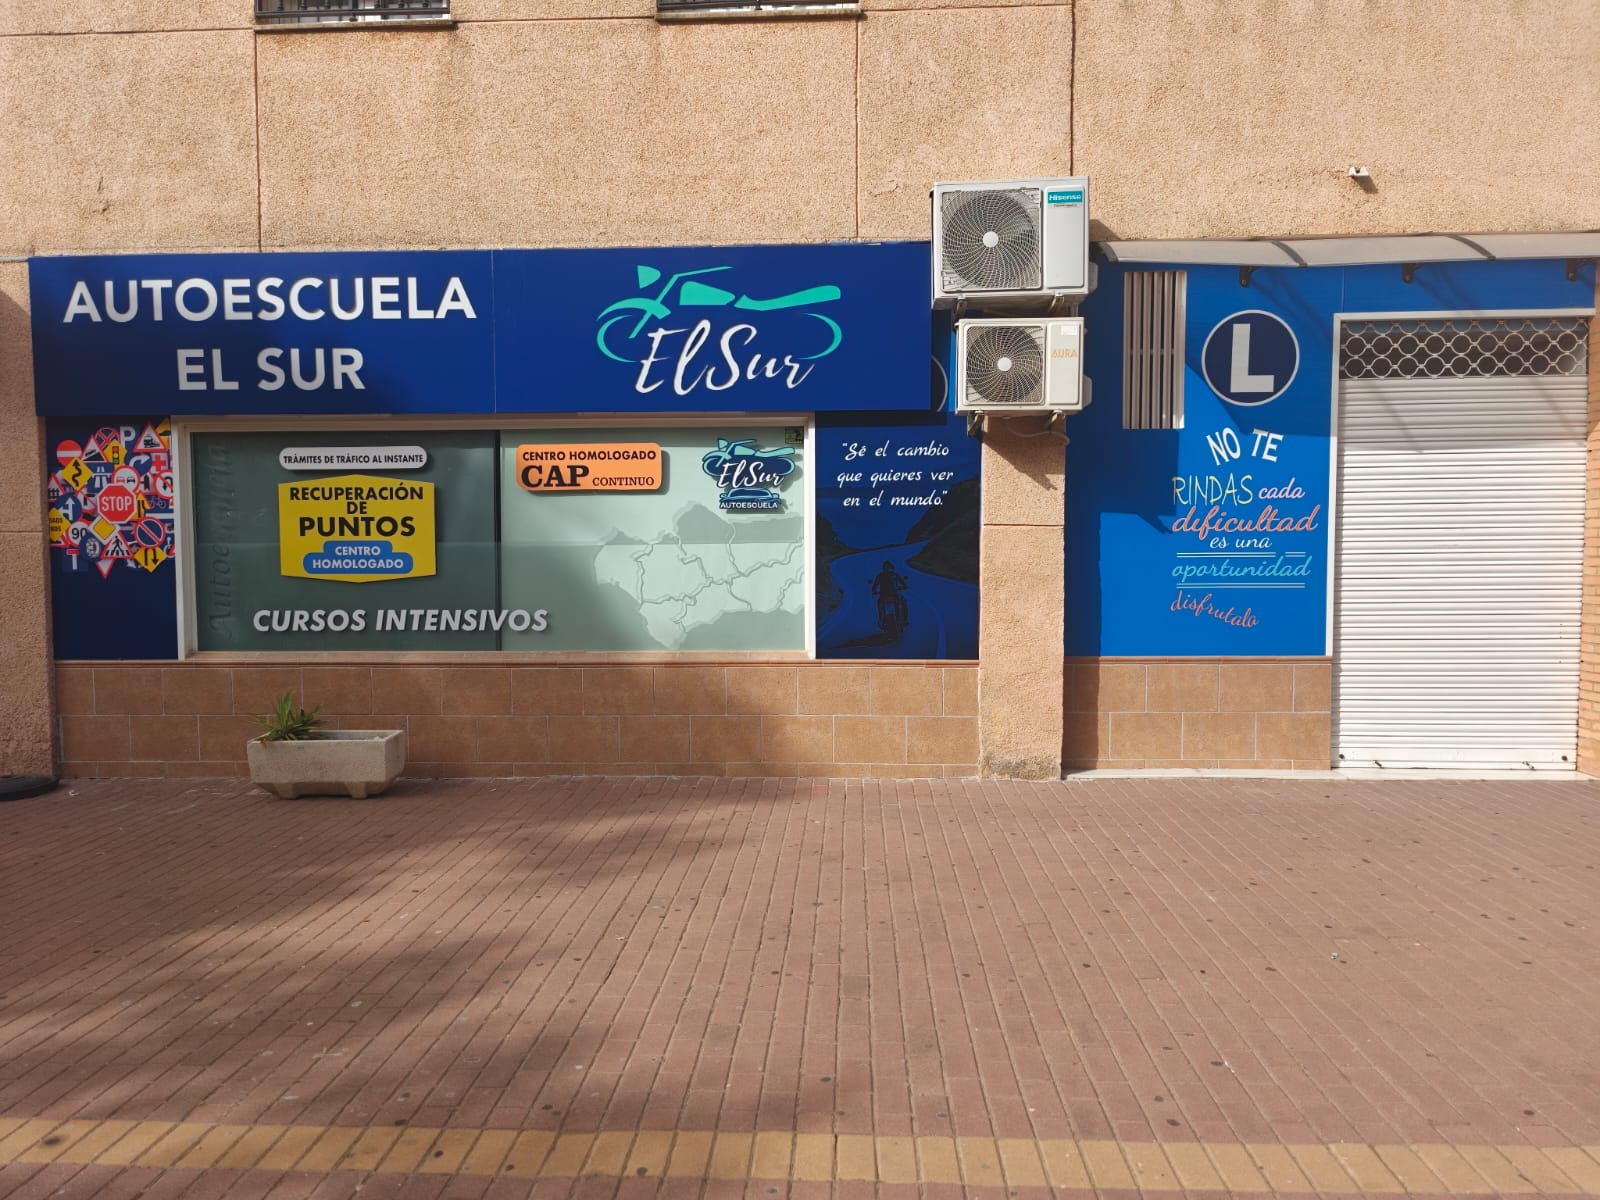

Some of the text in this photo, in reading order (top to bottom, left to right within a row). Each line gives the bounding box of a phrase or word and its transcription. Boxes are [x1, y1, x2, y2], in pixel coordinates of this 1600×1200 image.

[1049, 193, 1082, 201] Hisense
[62, 276, 478, 323] AUTOESCUELA
[1230, 323, 1275, 393] L
[176, 347, 366, 391] EL SUR
[522, 450, 657, 461] CENTRO HOMOLOGADO
[874, 440, 890, 457] el
[897, 440, 949, 457] cambio
[1205, 427, 1284, 466] NO TE
[324, 454, 335, 463] DE
[372, 454, 382, 463] AL
[384, 454, 424, 463] INSTANTE
[521, 464, 655, 488] CAP CONTINUO
[837, 469, 954, 488] que quieres ver
[290, 482, 424, 501] RECUPERACIÓN
[843, 496, 860, 507] en
[868, 489, 884, 507] el
[1171, 472, 1306, 507] RINDAS cada
[101, 496, 132, 512] STOP
[346, 501, 368, 515] DE
[299, 516, 416, 537] PUNTOS
[1171, 504, 1321, 541] dificultad
[334, 546, 381, 556] CENTRO
[1209, 536, 1273, 549] es una
[312, 559, 404, 569] HOMOLOGADO
[1171, 555, 1313, 583] oportunidad
[252, 608, 548, 632] CURSOS INTENSIVOS
